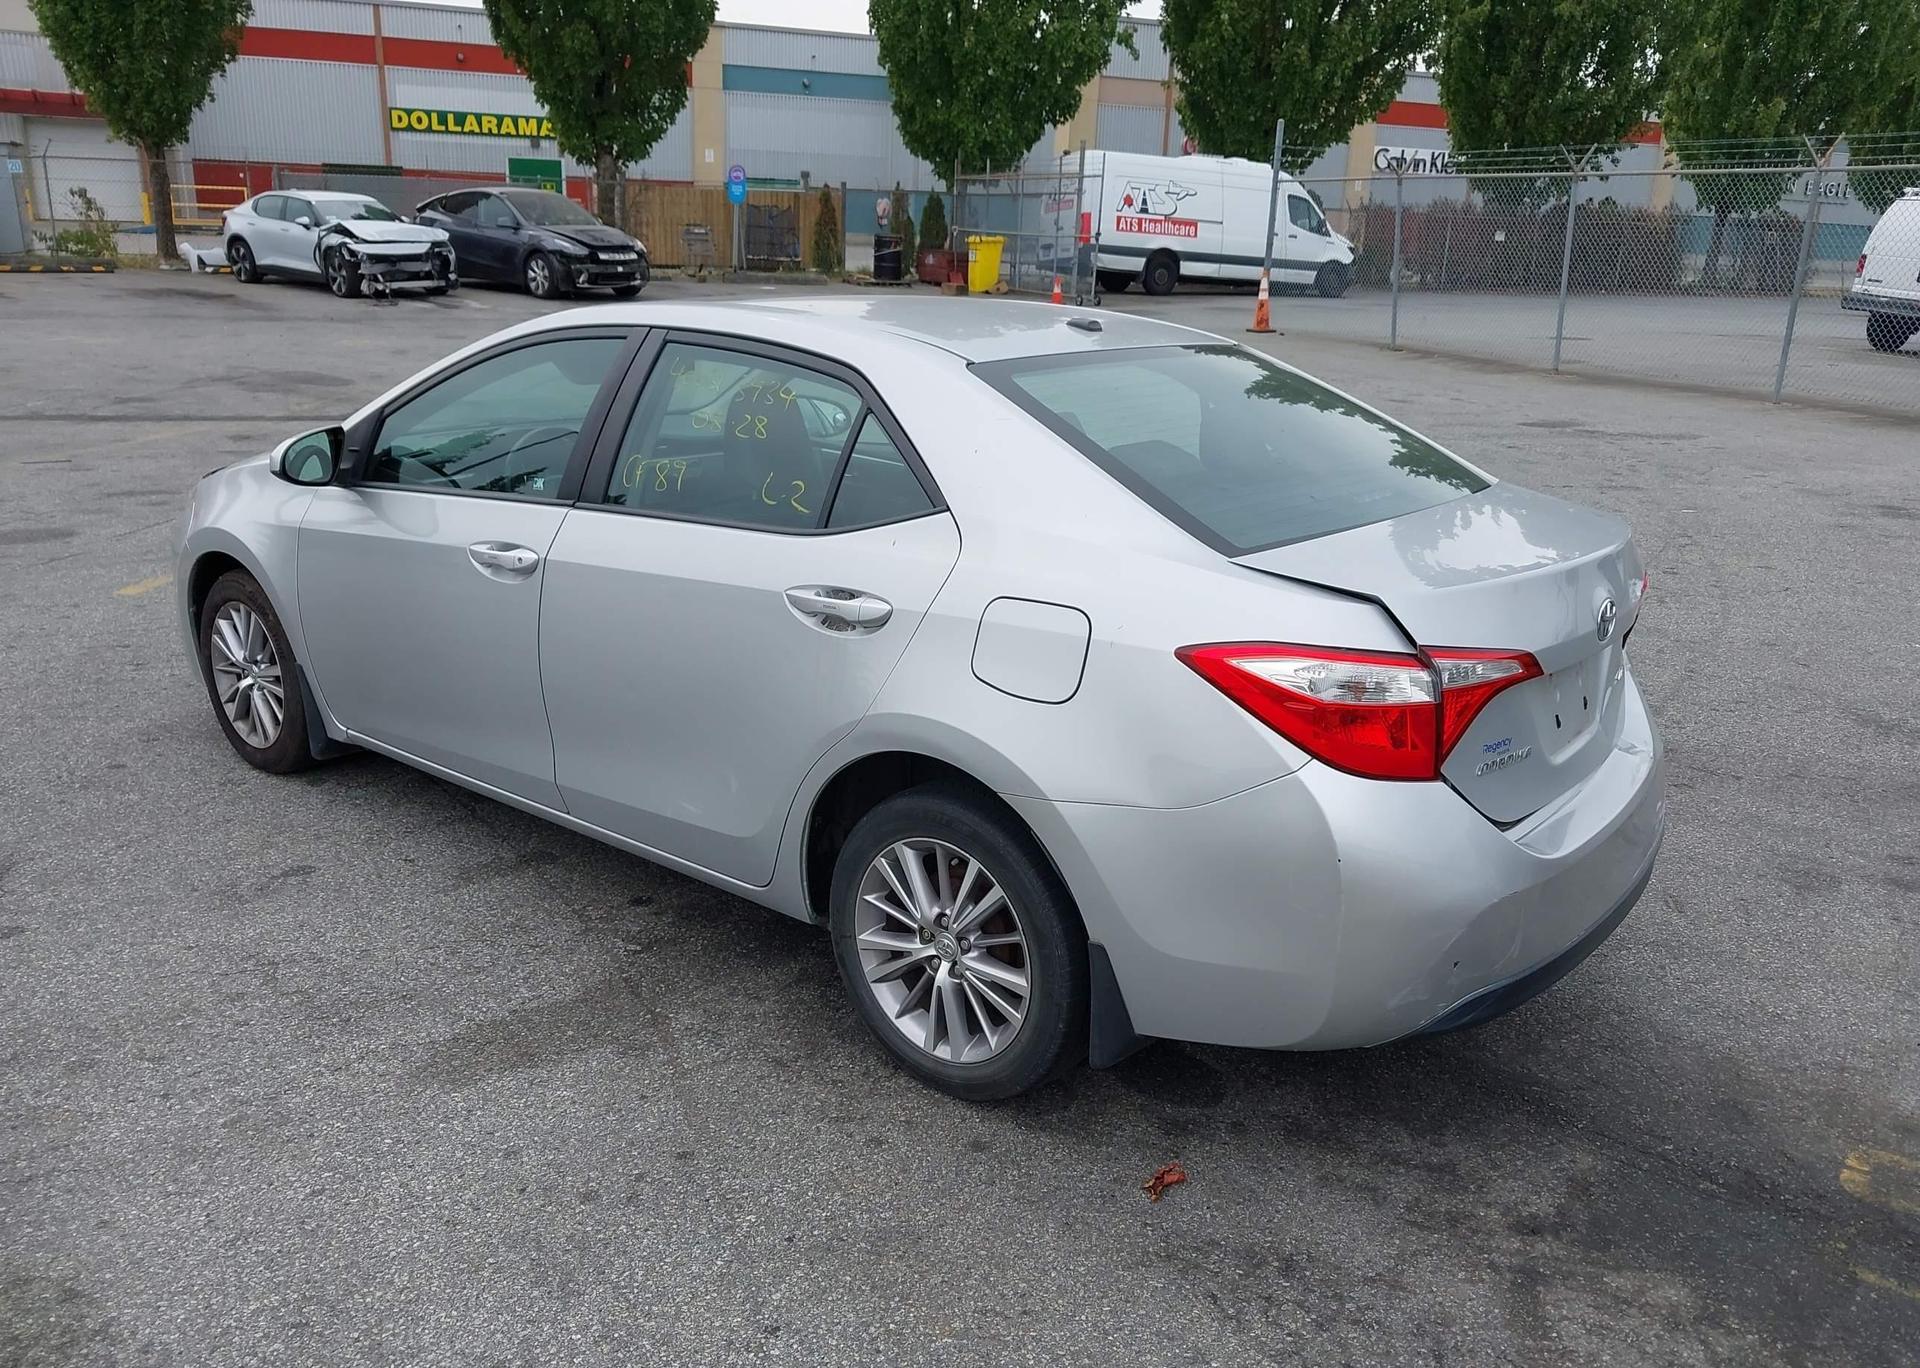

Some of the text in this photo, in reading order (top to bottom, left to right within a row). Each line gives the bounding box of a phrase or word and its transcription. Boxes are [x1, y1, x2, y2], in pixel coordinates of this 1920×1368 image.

[1374, 147, 1427, 173] Calvin
[1119, 217, 1196, 237] ATS Healthcare
[1482, 737, 1513, 755] Regency
